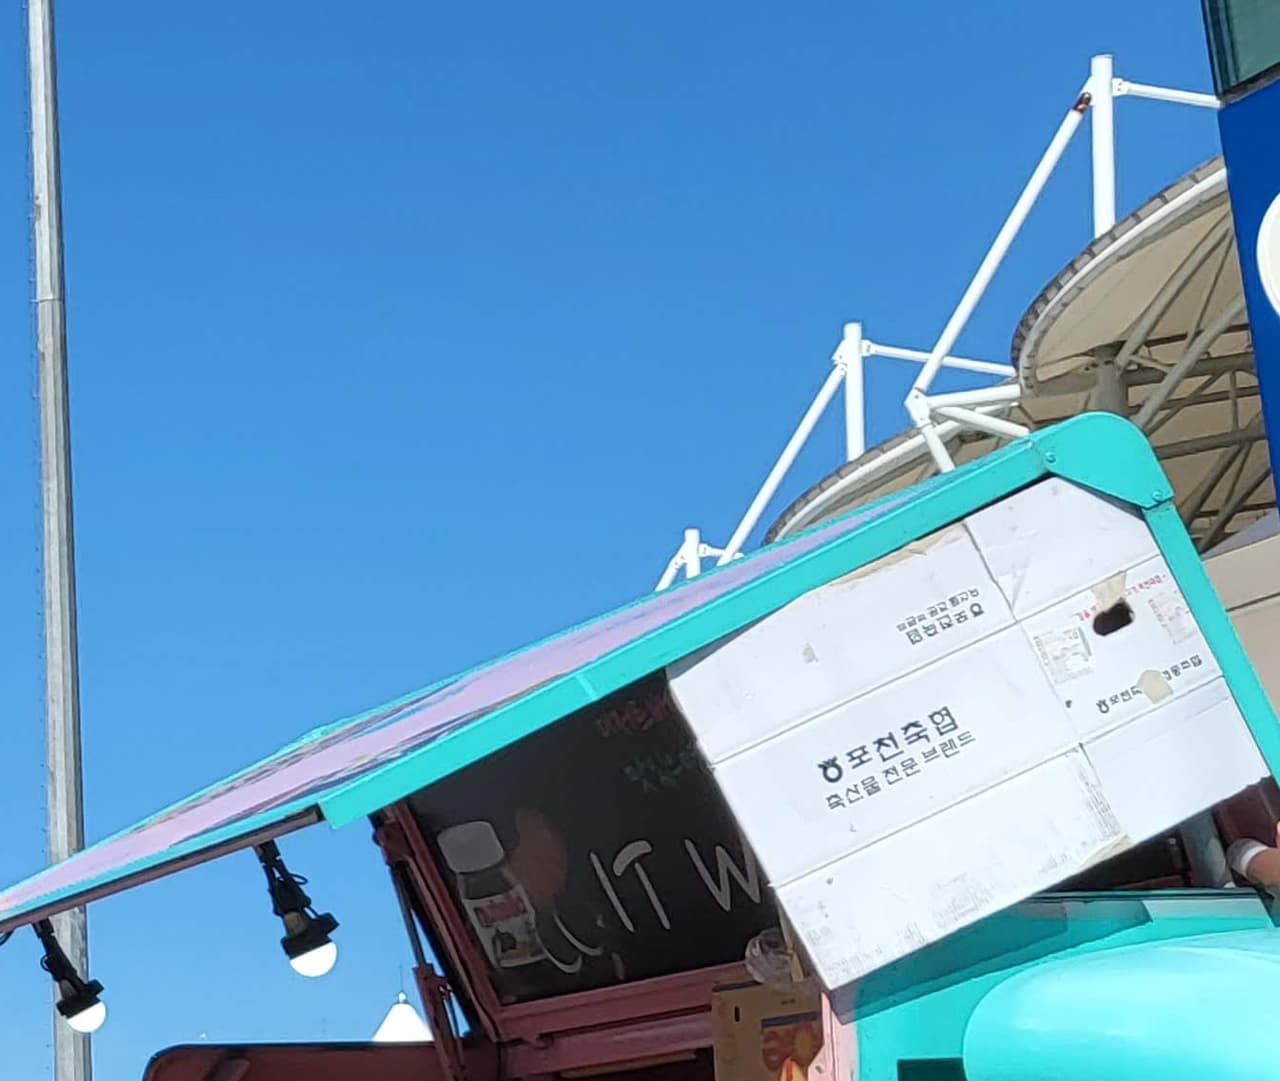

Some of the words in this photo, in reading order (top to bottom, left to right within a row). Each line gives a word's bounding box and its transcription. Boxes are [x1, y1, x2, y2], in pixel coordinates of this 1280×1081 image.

[845, 706, 959, 769] 포천축협
[825, 775, 882, 810] 축산물
[882, 758, 921, 785] 전문
[591, 839, 672, 932] IT
